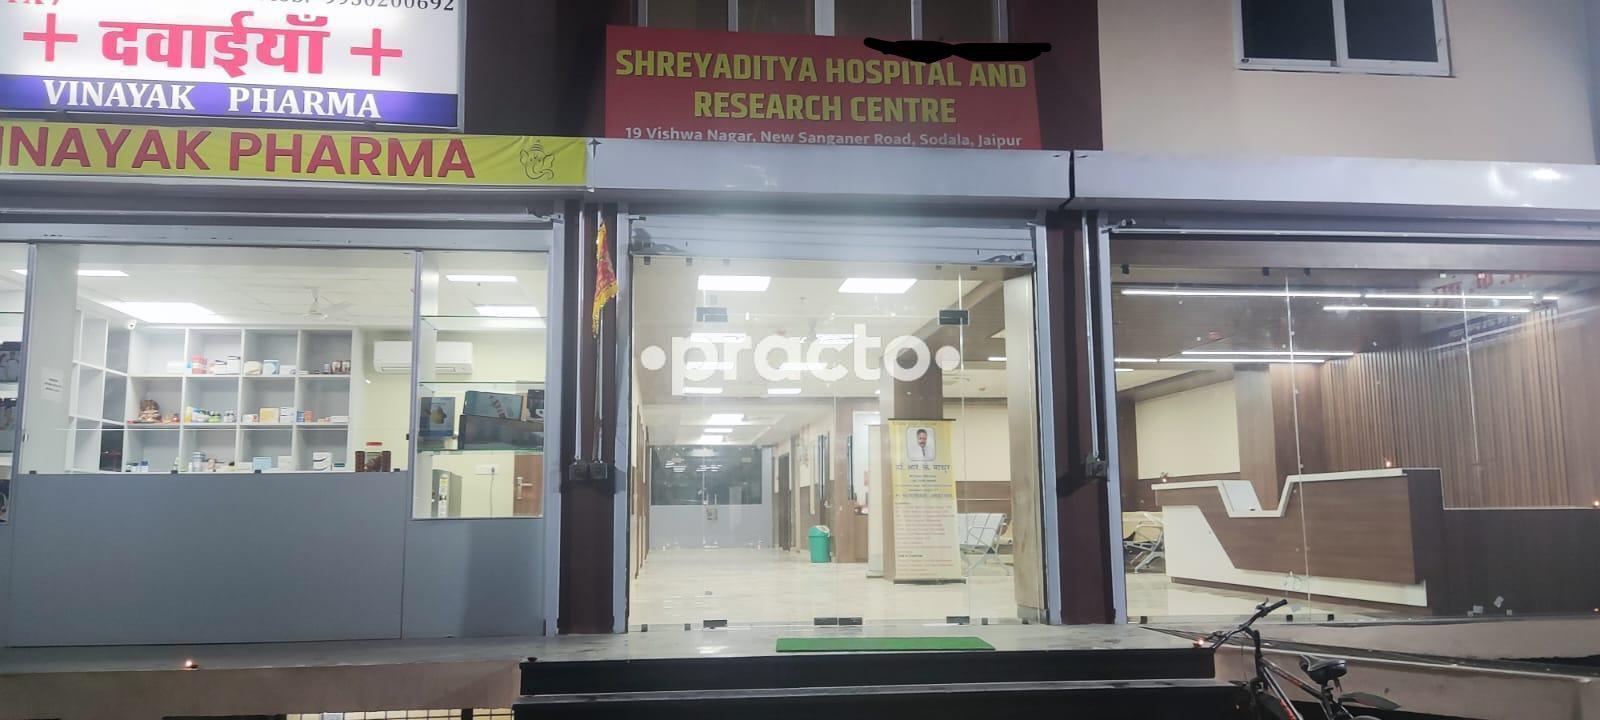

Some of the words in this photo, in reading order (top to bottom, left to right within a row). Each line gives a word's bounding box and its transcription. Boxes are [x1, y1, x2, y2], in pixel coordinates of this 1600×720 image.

[99, 11, 330, 78] दवाईयाँ
[615, 49, 818, 82] SHREYADITYA
[825, 58, 961, 87] HOSPITAL
[969, 63, 1027, 88] AND
[42, 79, 195, 111] VINAYAK
[227, 87, 381, 119] PHARMA
[694, 91, 842, 121] RESEARCH
[850, 97, 957, 124] CENTRE
[229, 132, 476, 179] PHARMA
[625, 127, 642, 139] 19
[647, 126, 702, 141] Vishwa
[707, 129, 757, 143] Nagar,
[761, 131, 794, 143] New
[799, 132, 868, 146] Sanganer
[874, 133, 916, 146] Road,
[920, 134, 974, 147] Sodala,
[978, 134, 1022, 149] Jaipur
